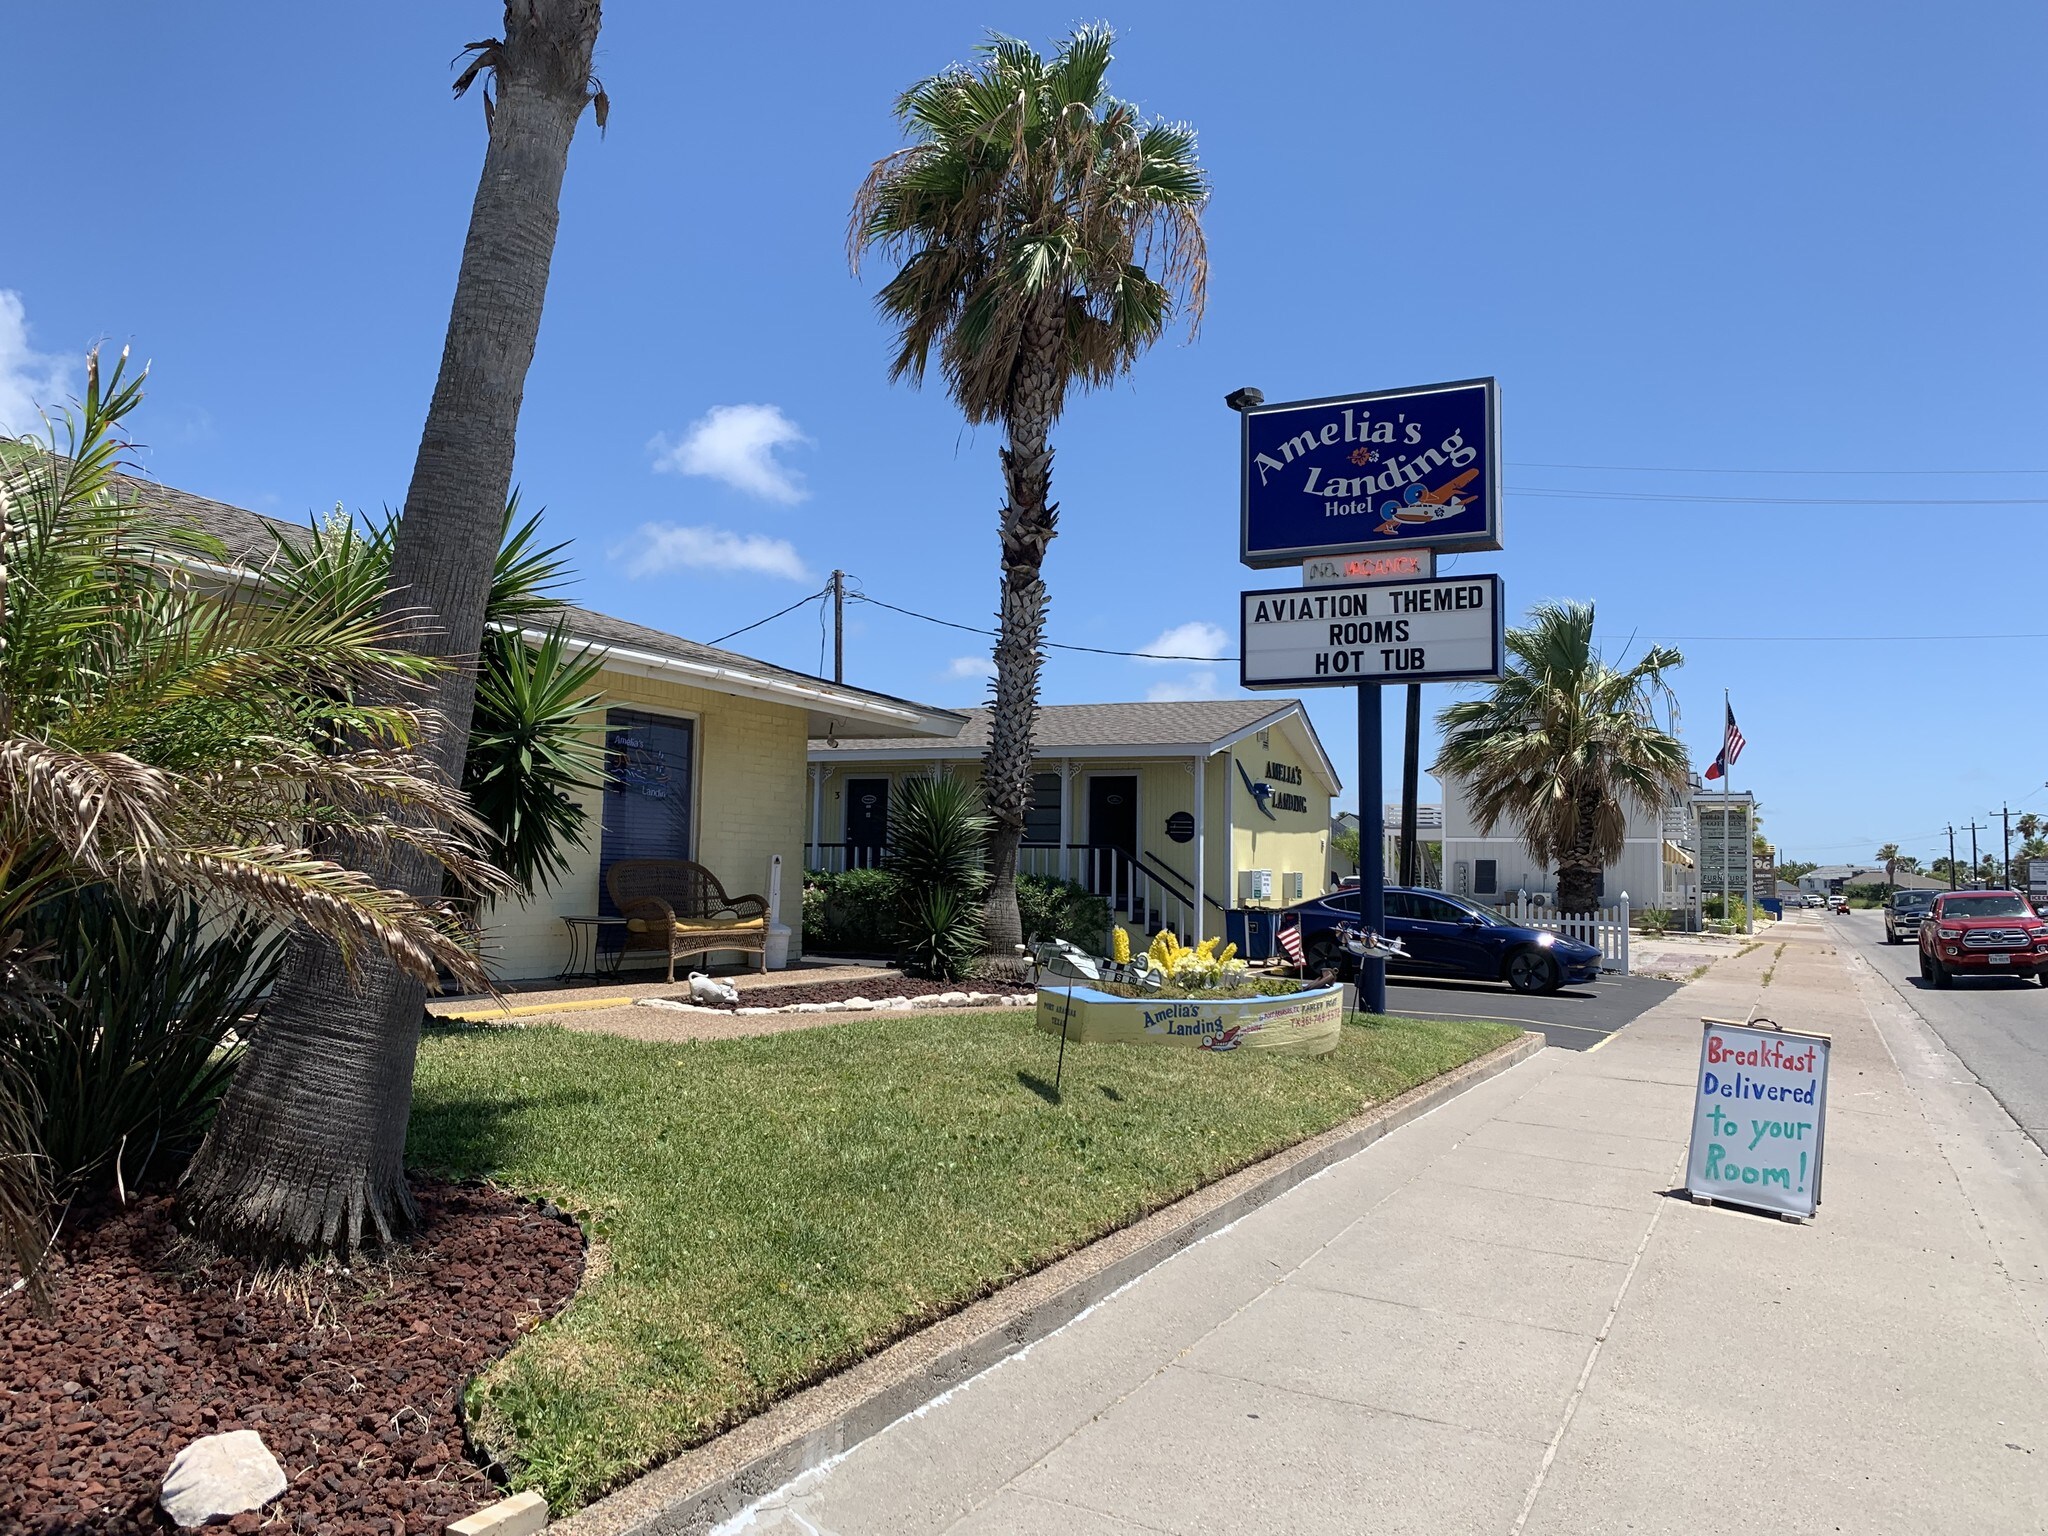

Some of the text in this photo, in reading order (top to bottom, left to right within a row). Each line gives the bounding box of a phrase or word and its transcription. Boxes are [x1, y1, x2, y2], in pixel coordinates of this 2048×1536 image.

[1254, 409, 1422, 487] Amelia's
[1303, 427, 1477, 498] Landing
[1325, 497, 1374, 517] Hotel
[1344, 557, 1419, 577] VACANCY
[1254, 585, 1484, 623] AVIATION THEMED
[1329, 619, 1410, 646] ROOMS
[1315, 647, 1425, 675] HOT TUB
[614, 735, 644, 748] Amelia's
[1265, 760, 1303, 786] AMELIA'S
[834, 791, 840, 800] 3
[1271, 791, 1308, 814] LANDING
[1143, 1004, 1200, 1028] Amelia's
[1166, 1016, 1224, 1036] Landing
[1708, 1036, 1817, 1073] Breakfast
[1703, 1072, 1817, 1106] Delivered
[1706, 1104, 1812, 1151] to your
